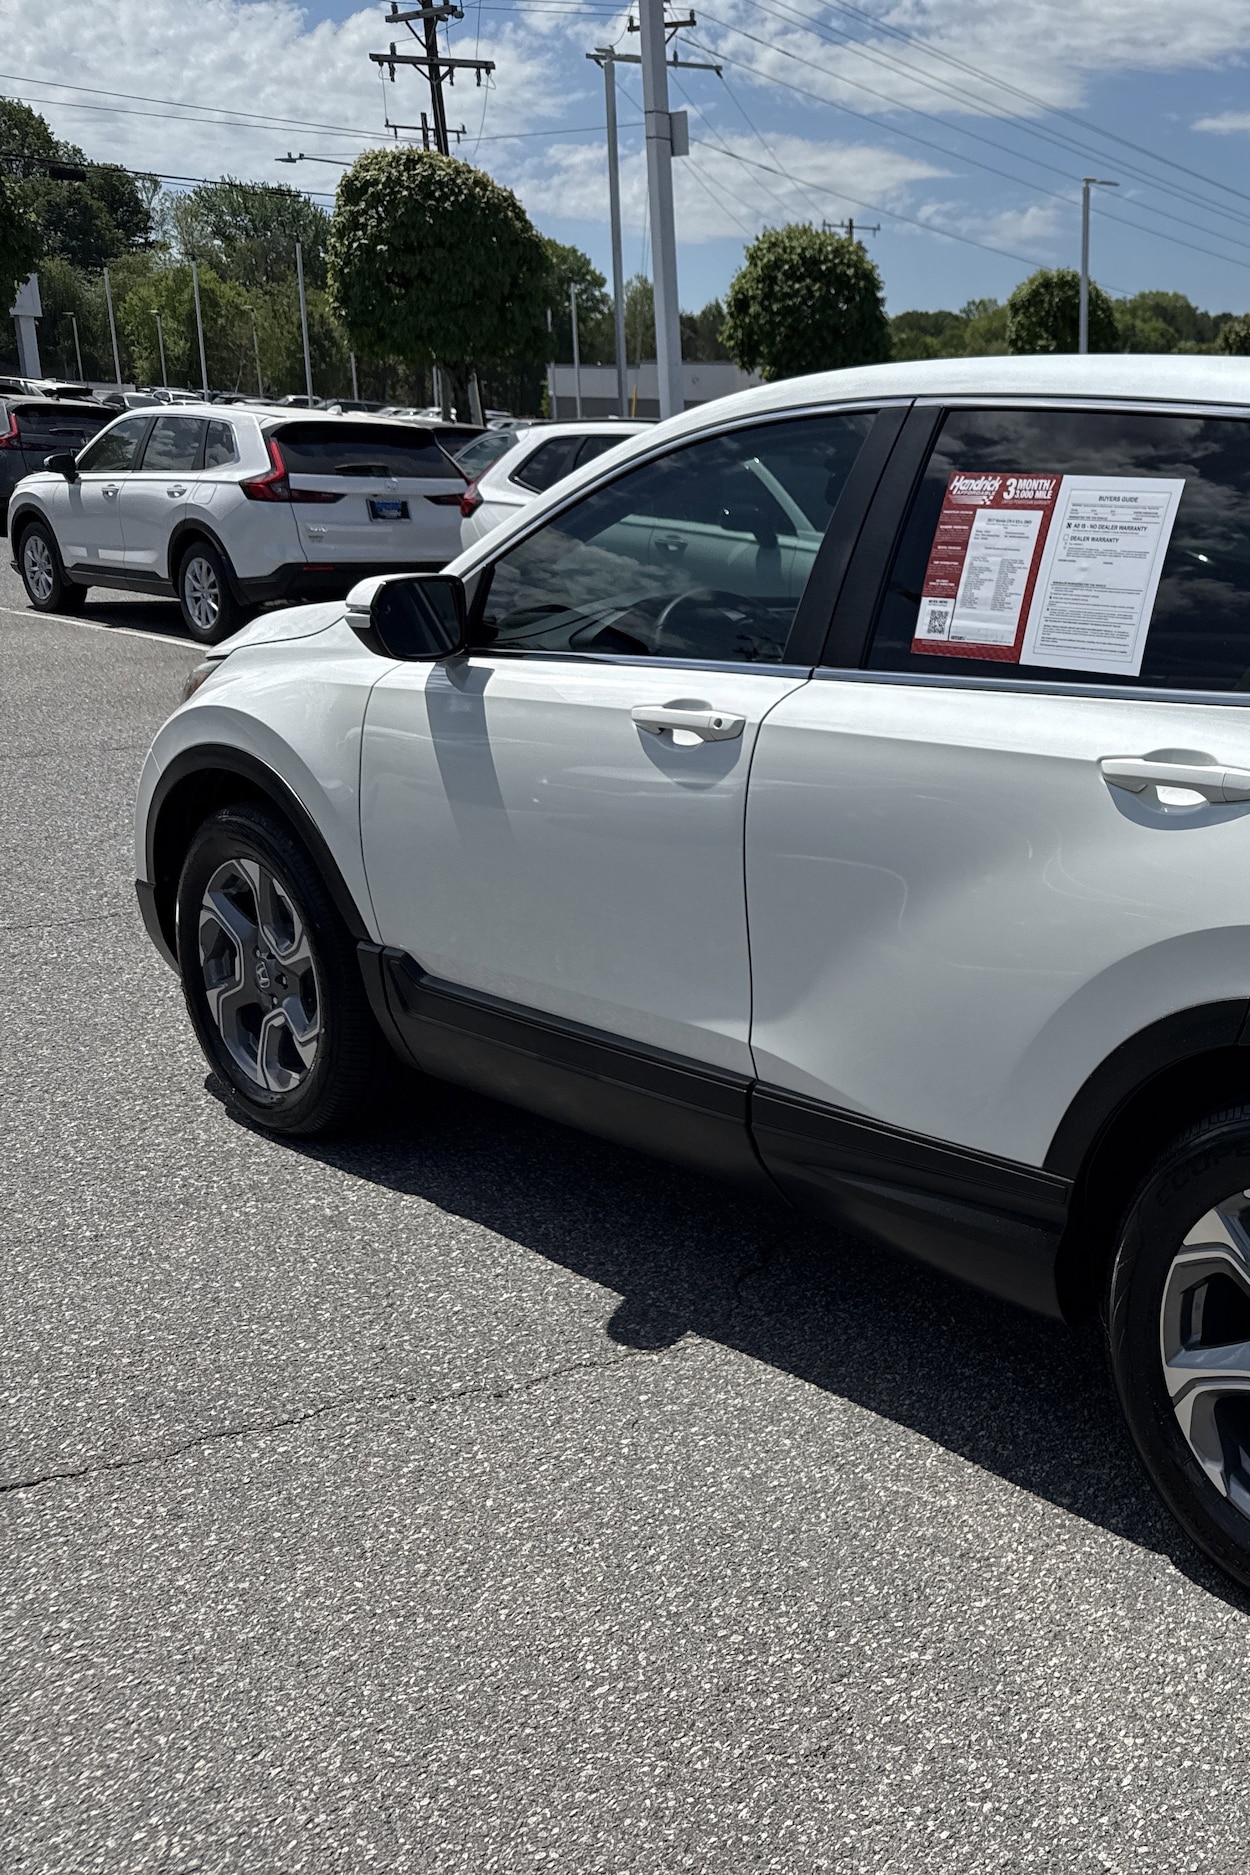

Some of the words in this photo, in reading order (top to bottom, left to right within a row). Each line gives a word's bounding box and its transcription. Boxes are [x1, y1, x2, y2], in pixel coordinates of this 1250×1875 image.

[950, 476, 1002, 494] Hendrick
[1003, 478, 1017, 500] 3
[1016, 479, 1056, 491] MONTH/
[1014, 490, 1034, 499] 3,000
[1034, 490, 1053, 499] MILE
[1098, 495, 1120, 503] BUYERS
[1121, 496, 1139, 504] GUIDE
